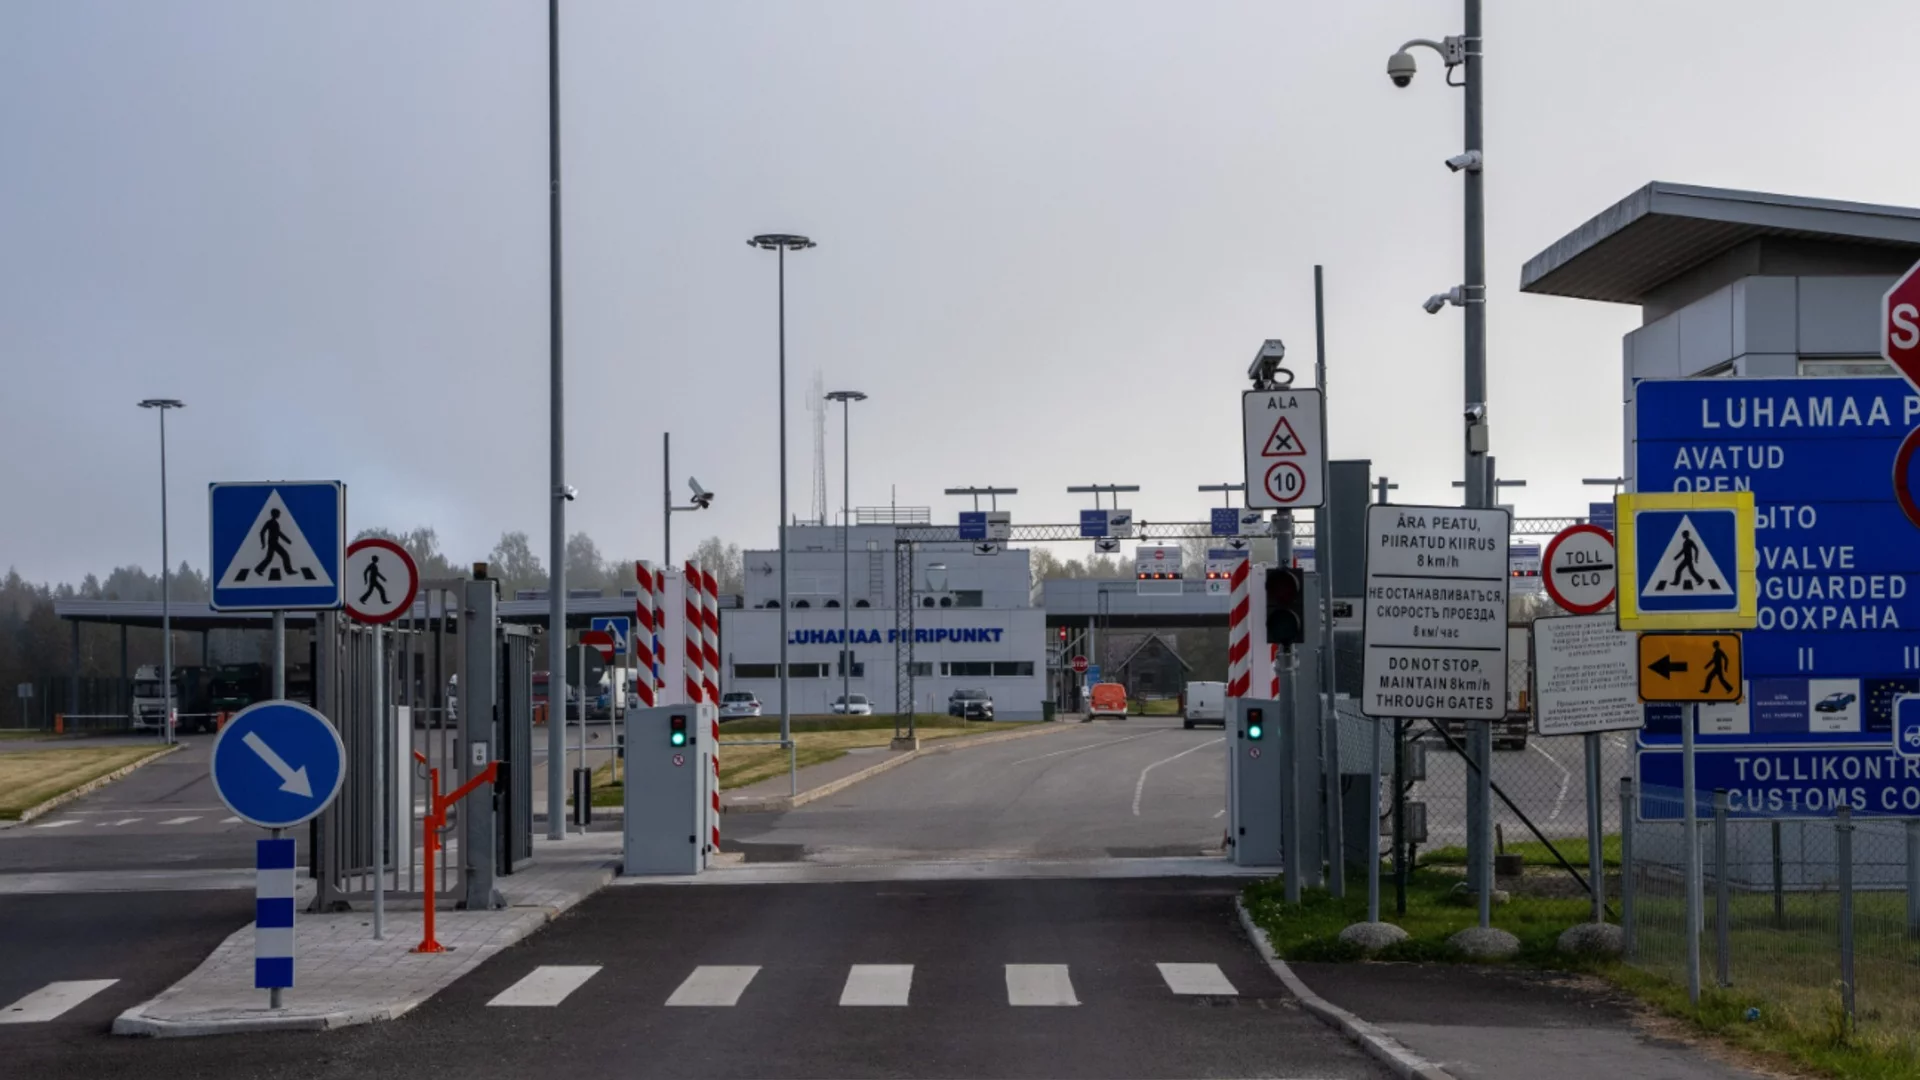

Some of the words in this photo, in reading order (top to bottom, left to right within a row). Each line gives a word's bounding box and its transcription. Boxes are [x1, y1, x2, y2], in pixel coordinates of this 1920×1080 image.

[1268, 396, 1298, 410] ALA
[1702, 396, 1891, 428] LUHAMAA
[1674, 446, 1784, 470] AVATUD
[1274, 472, 1296, 492] 10
[1674, 476, 1750, 492] OPEN
[1397, 513, 1426, 528] ÄRA
[1432, 516, 1480, 532] PEATU,
[1382, 534, 1445, 548] PIIRATUD
[1449, 537, 1496, 550] KIIRUS
[1566, 550, 1603, 564] TOLL
[1756, 546, 1855, 570] VALVE
[1571, 572, 1600, 587] CLO
[1369, 588, 1384, 599] НЕ
[1756, 576, 1906, 600] GUARDED
[1442, 607, 1496, 622] ПРОЕЗДА
[788, 628, 882, 644] LUHAMAA
[1390, 657, 1408, 670] DO
[1412, 658, 1440, 670] NOT
[1380, 676, 1446, 690] MAINTAIN
[1376, 694, 1444, 708] THROUGH
[1448, 696, 1494, 710] GATES
[1727, 787, 1867, 811] CUSTOMS
